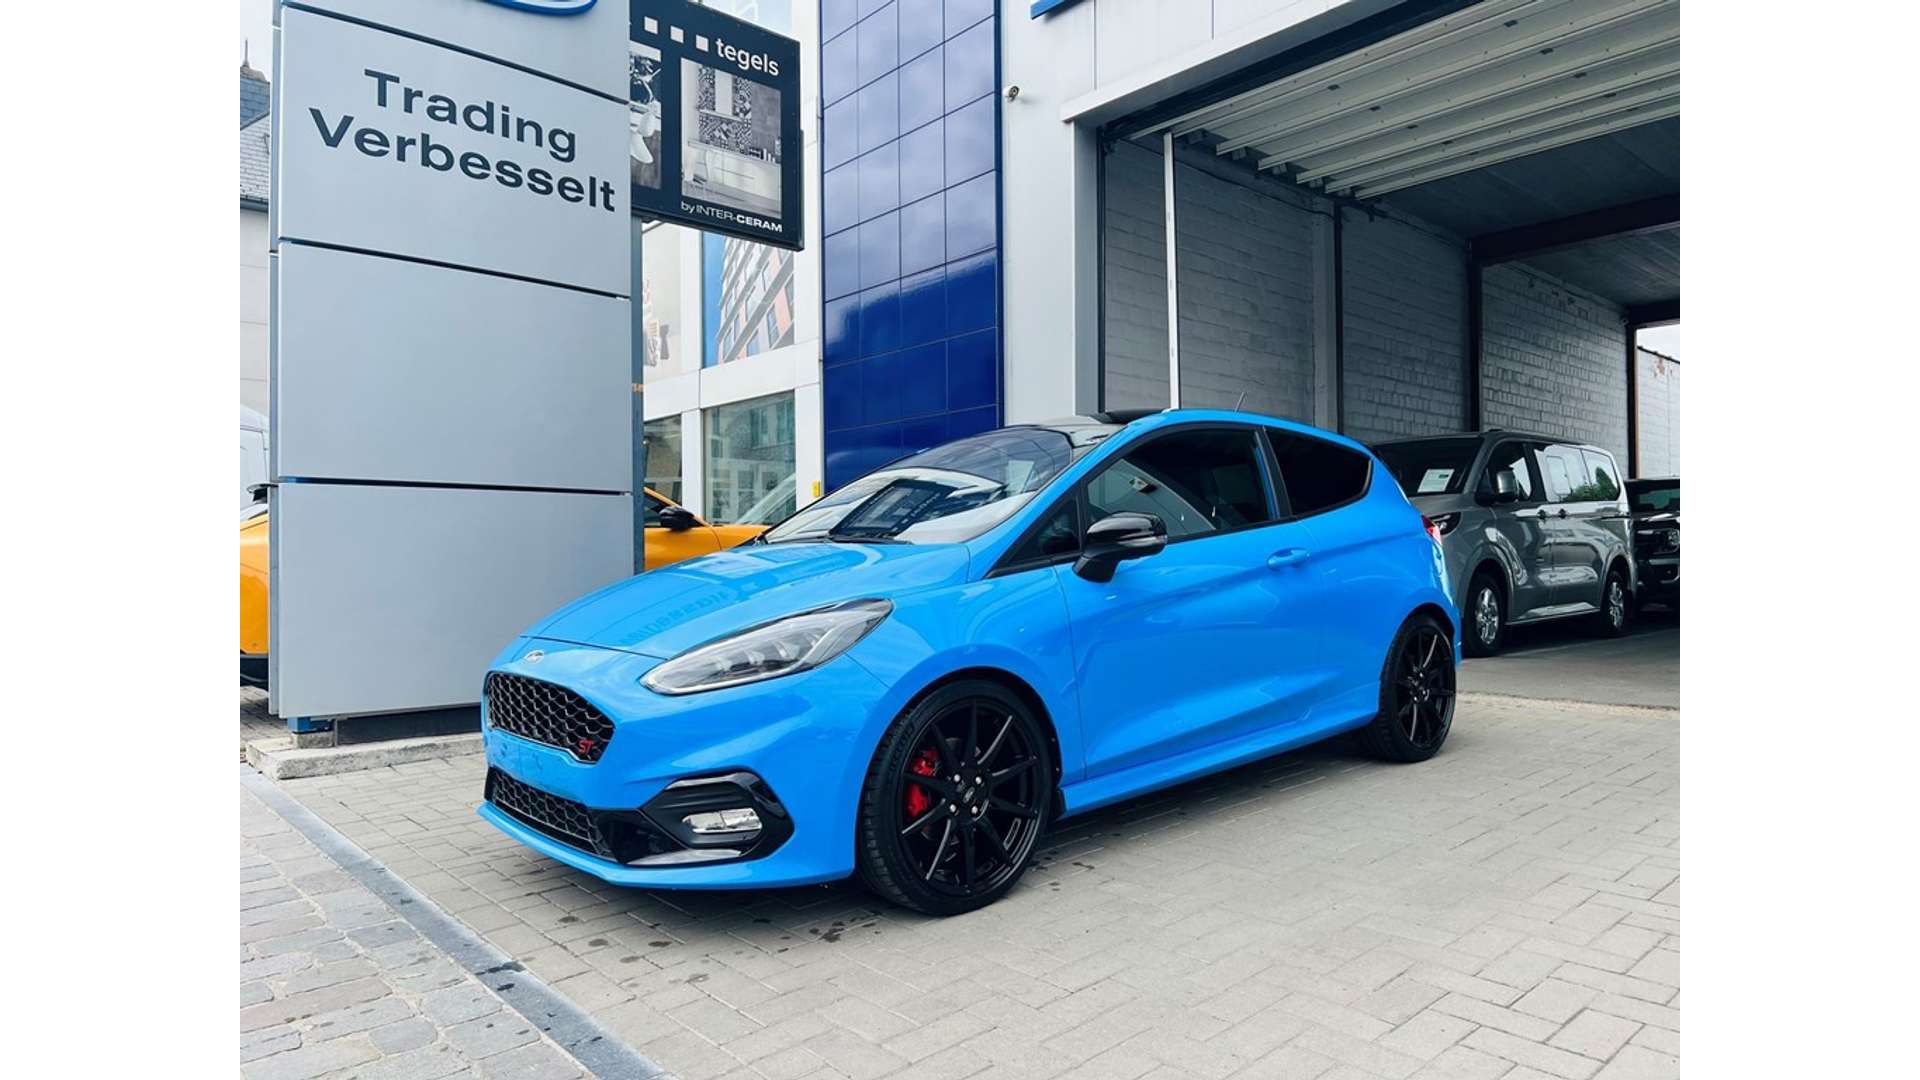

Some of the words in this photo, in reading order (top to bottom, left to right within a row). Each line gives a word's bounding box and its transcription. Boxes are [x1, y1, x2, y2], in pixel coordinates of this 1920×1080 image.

[715, 38, 779, 76] tegels
[364, 68, 576, 163] Trading
[308, 106, 615, 212] Verbesselt
[681, 201, 695, 214] by
[696, 205, 782, 232] INTER-CERAM
[578, 739, 594, 754] ST
